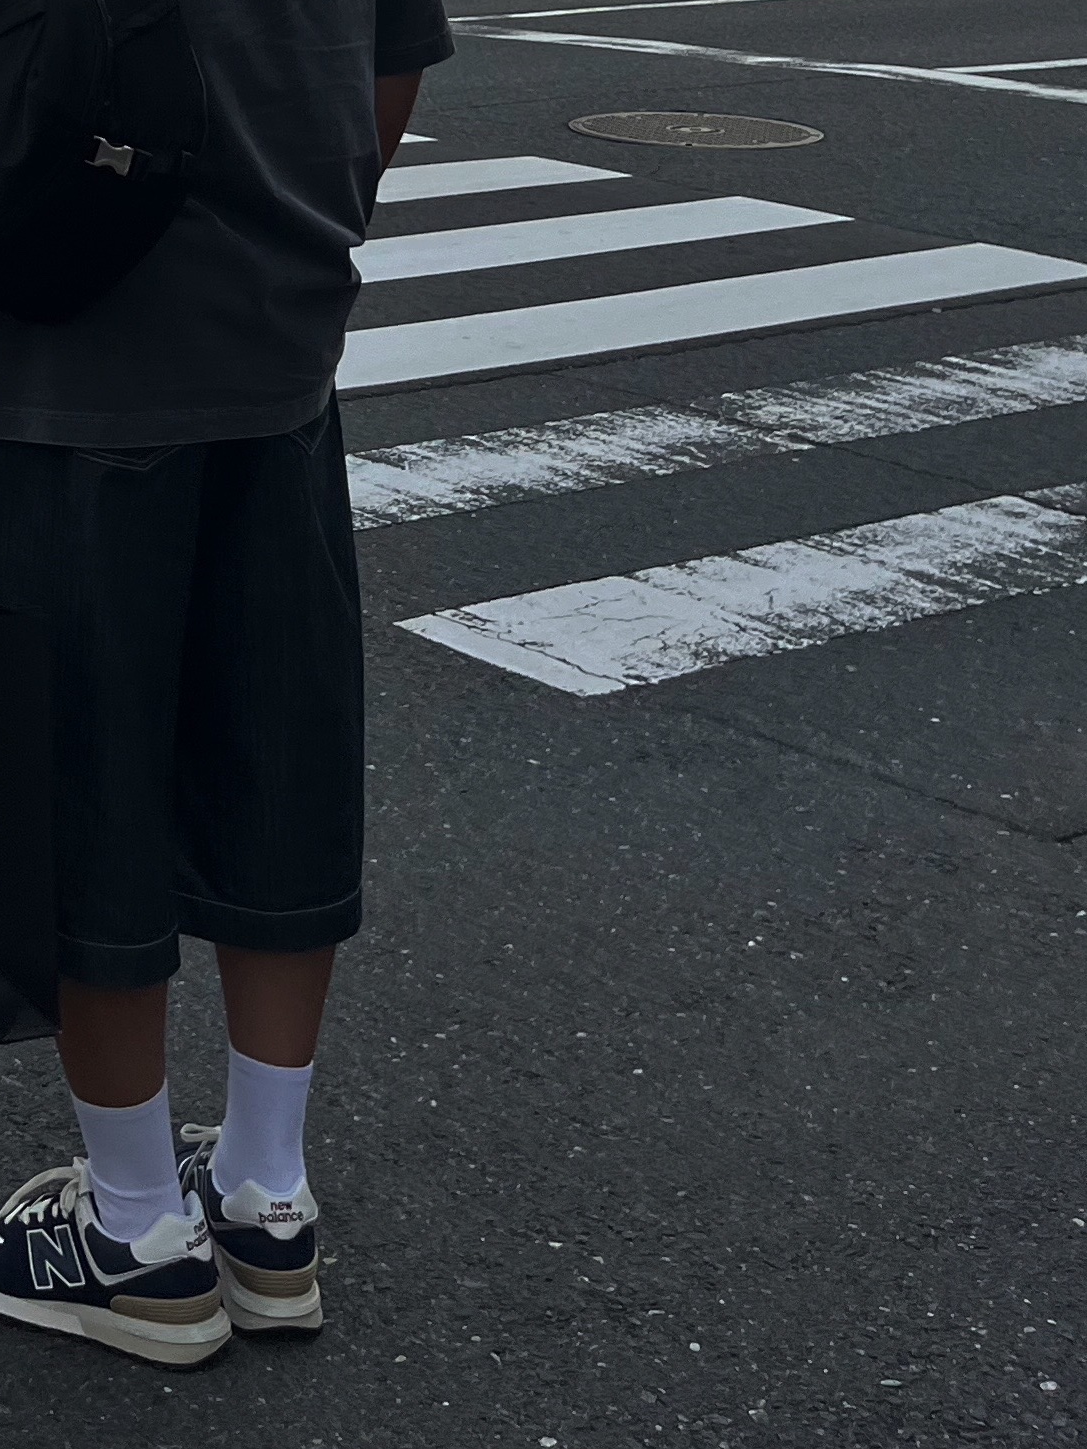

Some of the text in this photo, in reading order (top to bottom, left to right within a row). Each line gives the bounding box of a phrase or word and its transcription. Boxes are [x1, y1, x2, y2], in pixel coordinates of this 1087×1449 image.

[270, 1201, 293, 1211] new
[258, 1211, 304, 1223] balance
[26, 1224, 86, 1290] N
